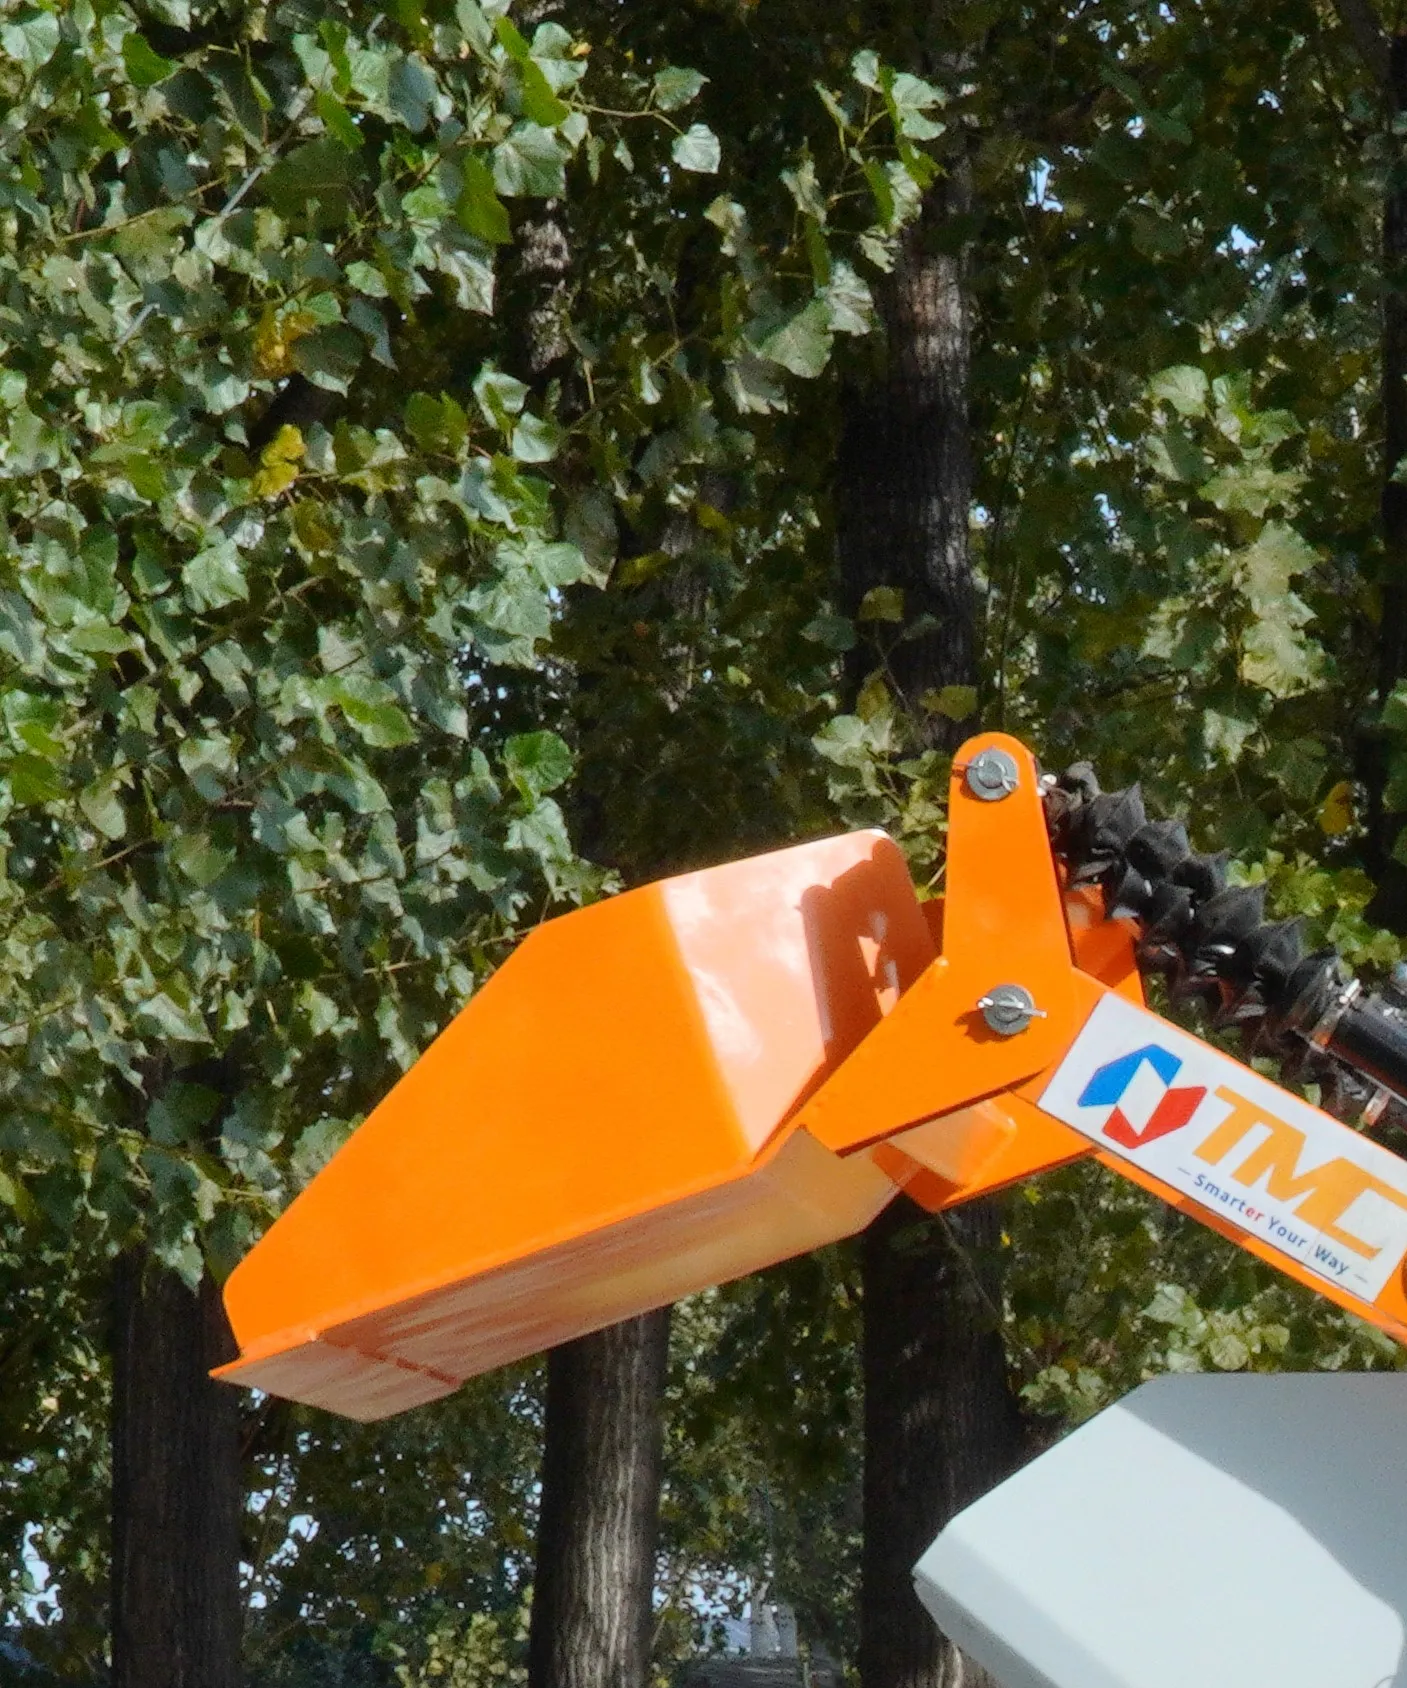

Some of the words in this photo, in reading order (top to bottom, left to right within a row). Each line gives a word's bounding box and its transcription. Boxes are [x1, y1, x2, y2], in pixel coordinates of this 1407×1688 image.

[1193, 1174, 1265, 1222] Smarter
[1268, 1216, 1308, 1248] Your
[1314, 1244, 1350, 1276] Way
